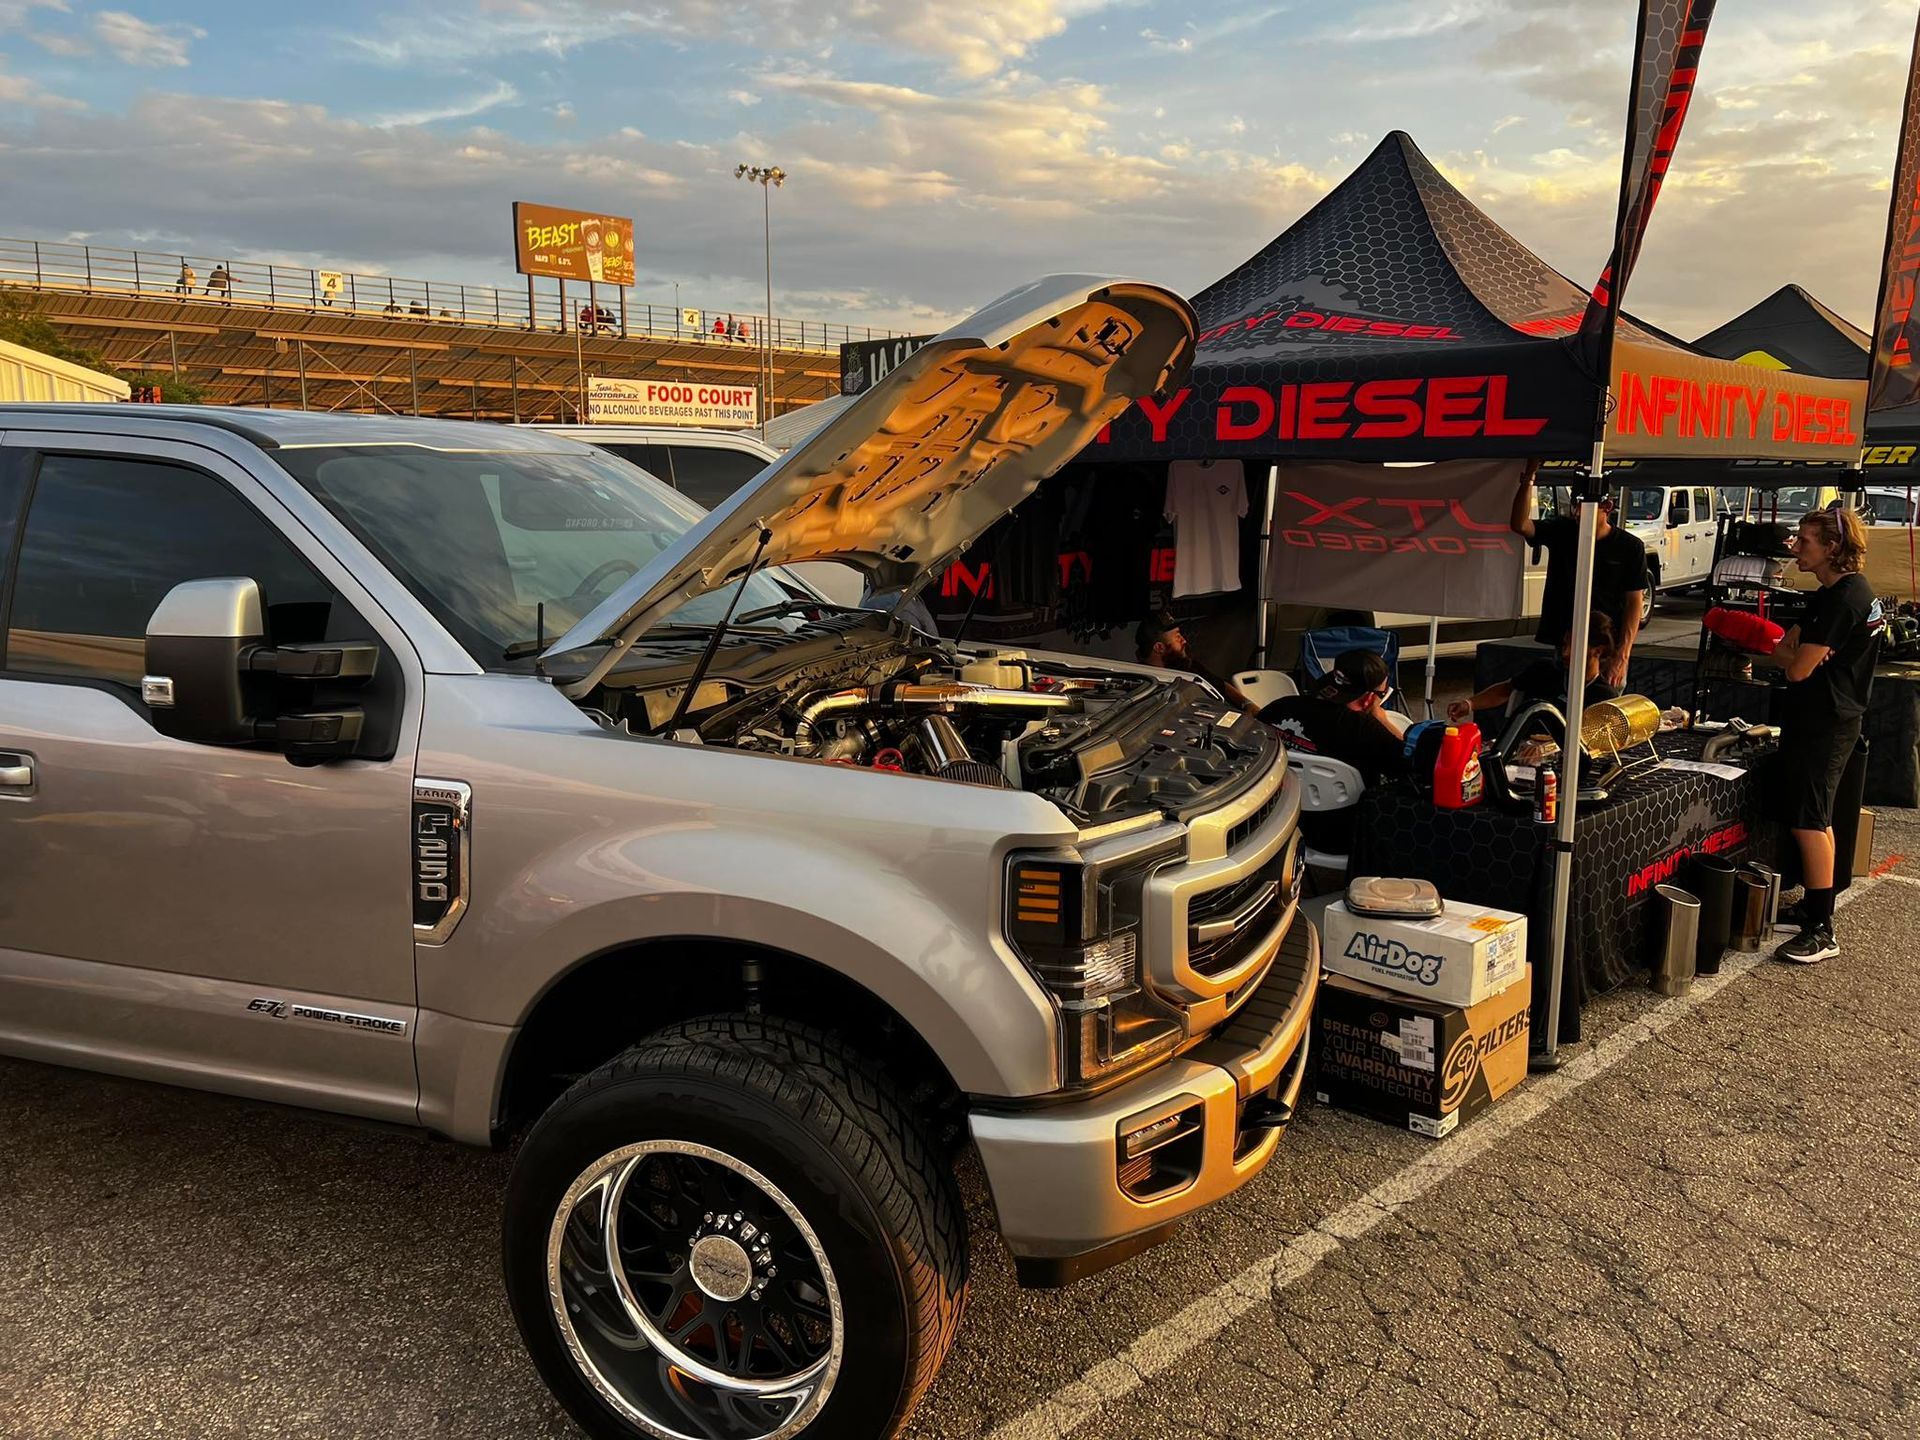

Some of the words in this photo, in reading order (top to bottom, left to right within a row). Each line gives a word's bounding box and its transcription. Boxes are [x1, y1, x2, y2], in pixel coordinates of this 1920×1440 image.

[525, 223, 580, 251] BEAST
[326, 277, 337, 290] 4
[687, 314, 695, 324] 4
[1282, 310, 1466, 342] DIESEL
[647, 385, 693, 403] FOOD
[698, 388, 753, 406] COURT
[1215, 375, 1550, 441] DIESEL
[1615, 369, 1768, 440] INFINITY
[1771, 391, 1858, 446] DIESEL
[589, 404, 600, 415] NO
[603, 404, 647, 416] ALCOHOLIC
[649, 406, 693, 417] BEVERAGES
[694, 408, 712, 418] PAST
[714, 409, 731, 419] THIS
[732, 410, 754, 421] POINT
[416, 789, 460, 800] LARIAT
[1343, 931, 1444, 986] AirDog
[293, 1007, 342, 1022] POWER
[344, 1015, 402, 1032] STROKE
[1323, 1030, 1367, 1056] YOUR
[1321, 1046, 1334, 1061] &
[1335, 1050, 1434, 1090] WARRANTY
[1321, 1060, 1349, 1080] ARE
